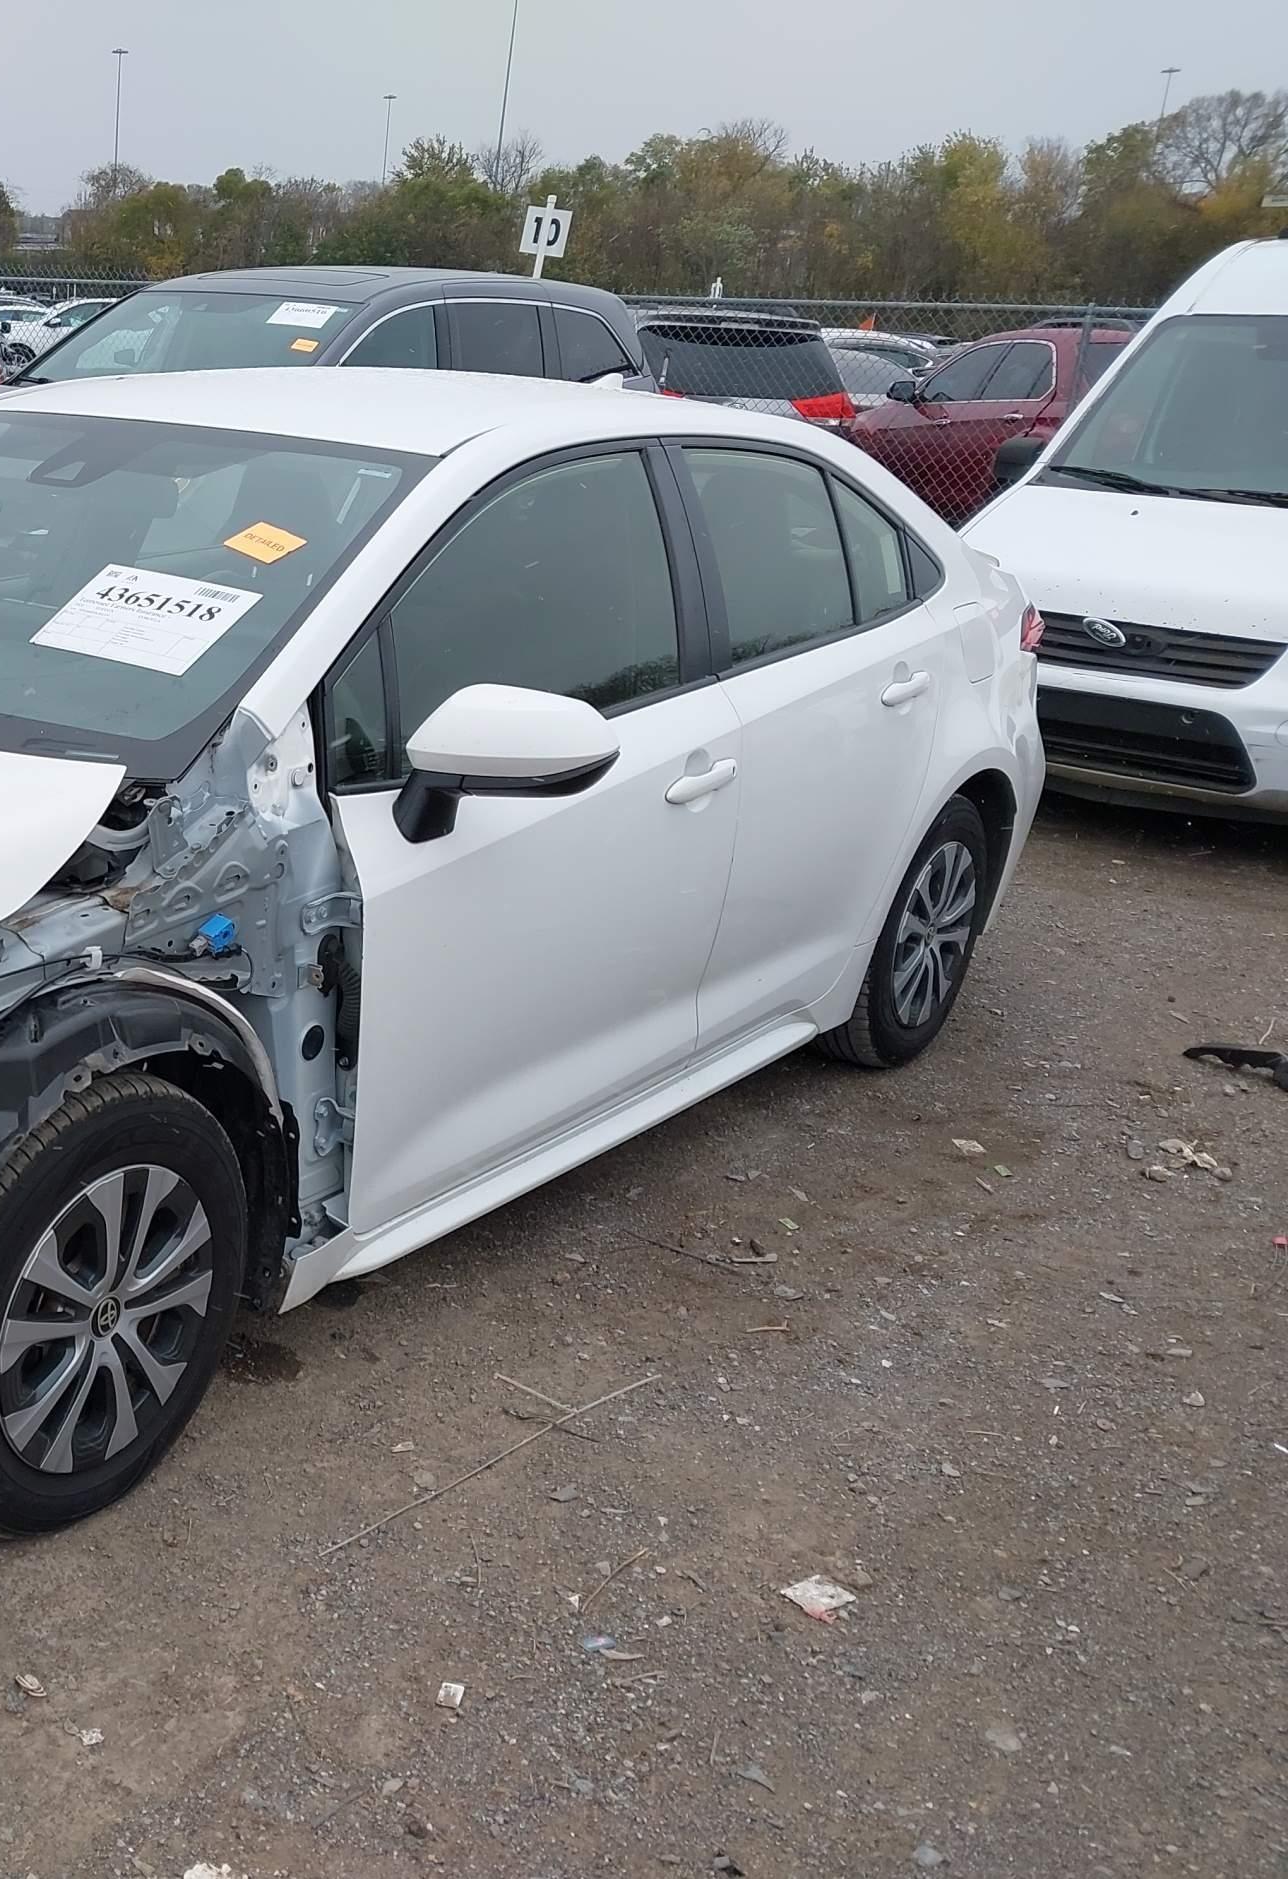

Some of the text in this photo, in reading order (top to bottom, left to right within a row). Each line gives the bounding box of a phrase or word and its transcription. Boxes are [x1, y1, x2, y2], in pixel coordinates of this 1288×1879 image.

[243, 532, 286, 553] DETAILED
[96, 586, 222, 622] 43651518
[1091, 623, 1117, 641] Ford
